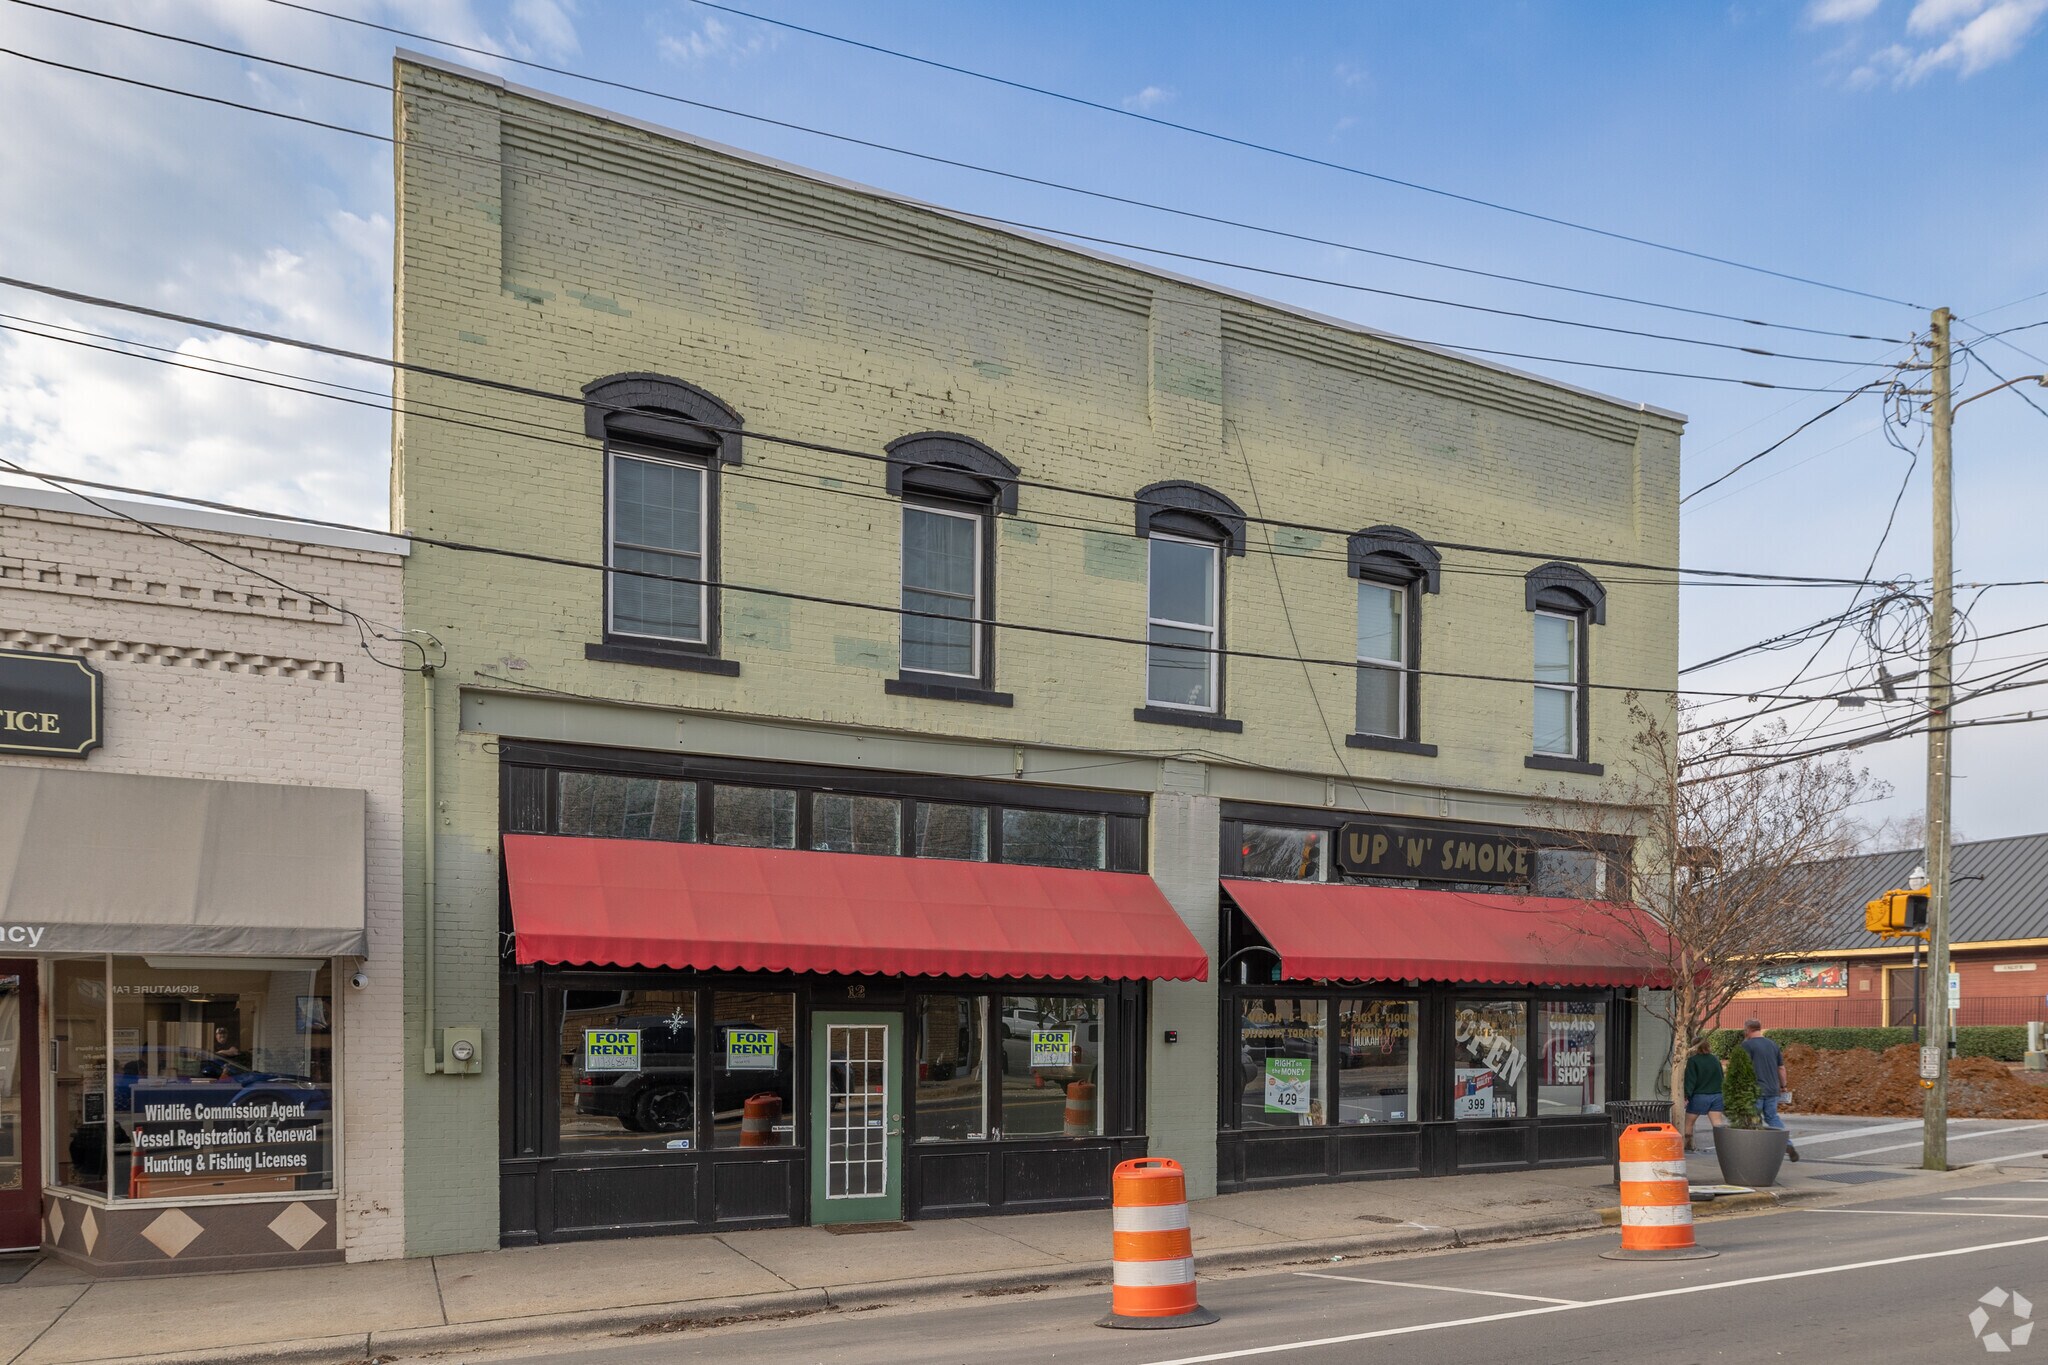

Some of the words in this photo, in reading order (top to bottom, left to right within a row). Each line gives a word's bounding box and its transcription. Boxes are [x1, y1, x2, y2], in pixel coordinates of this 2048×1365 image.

[0, 709, 60, 734] ICE
[1350, 832, 1388, 865] UP
[1398, 836, 1433, 867] 'N'
[1441, 839, 1529, 875] SMOKE
[847, 985, 866, 999] 12
[1248, 1012, 1282, 1023] VAPOR
[1549, 1015, 1596, 1031] CIGARS
[596, 1033, 630, 1044] FOR
[736, 1033, 768, 1043] FOR
[1038, 1033, 1064, 1043] FOR
[1244, 1028, 1286, 1039] DISCOUNT
[1287, 1028, 1325, 1039] TOBACCO
[1353, 1033, 1380, 1047] HOOKAH
[590, 1044, 636, 1055] RENT
[731, 1044, 773, 1054] RENT
[1034, 1043, 1068, 1052] RENT
[1455, 1009, 1527, 1088] OPEN
[1274, 1059, 1296, 1067] RIGHT
[1555, 1051, 1591, 1067] SMOKE
[1281, 1068, 1306, 1076] MONEY
[1557, 1067, 1588, 1083] SHOP
[1277, 1093, 1297, 1106] 429
[1468, 1098, 1485, 1110] 399
[144, 1103, 191, 1122] Wildlife
[194, 1102, 268, 1120] Commission
[270, 1101, 305, 1121] Agent
[132, 1130, 174, 1148] Vessel
[177, 1127, 252, 1149] Registration
[254, 1127, 264, 1143] &
[267, 1125, 317, 1143] Renewal
[144, 1155, 192, 1175] Hunting
[196, 1154, 206, 1171] &
[209, 1153, 252, 1172] Fishing
[255, 1151, 307, 1168] Licenses
